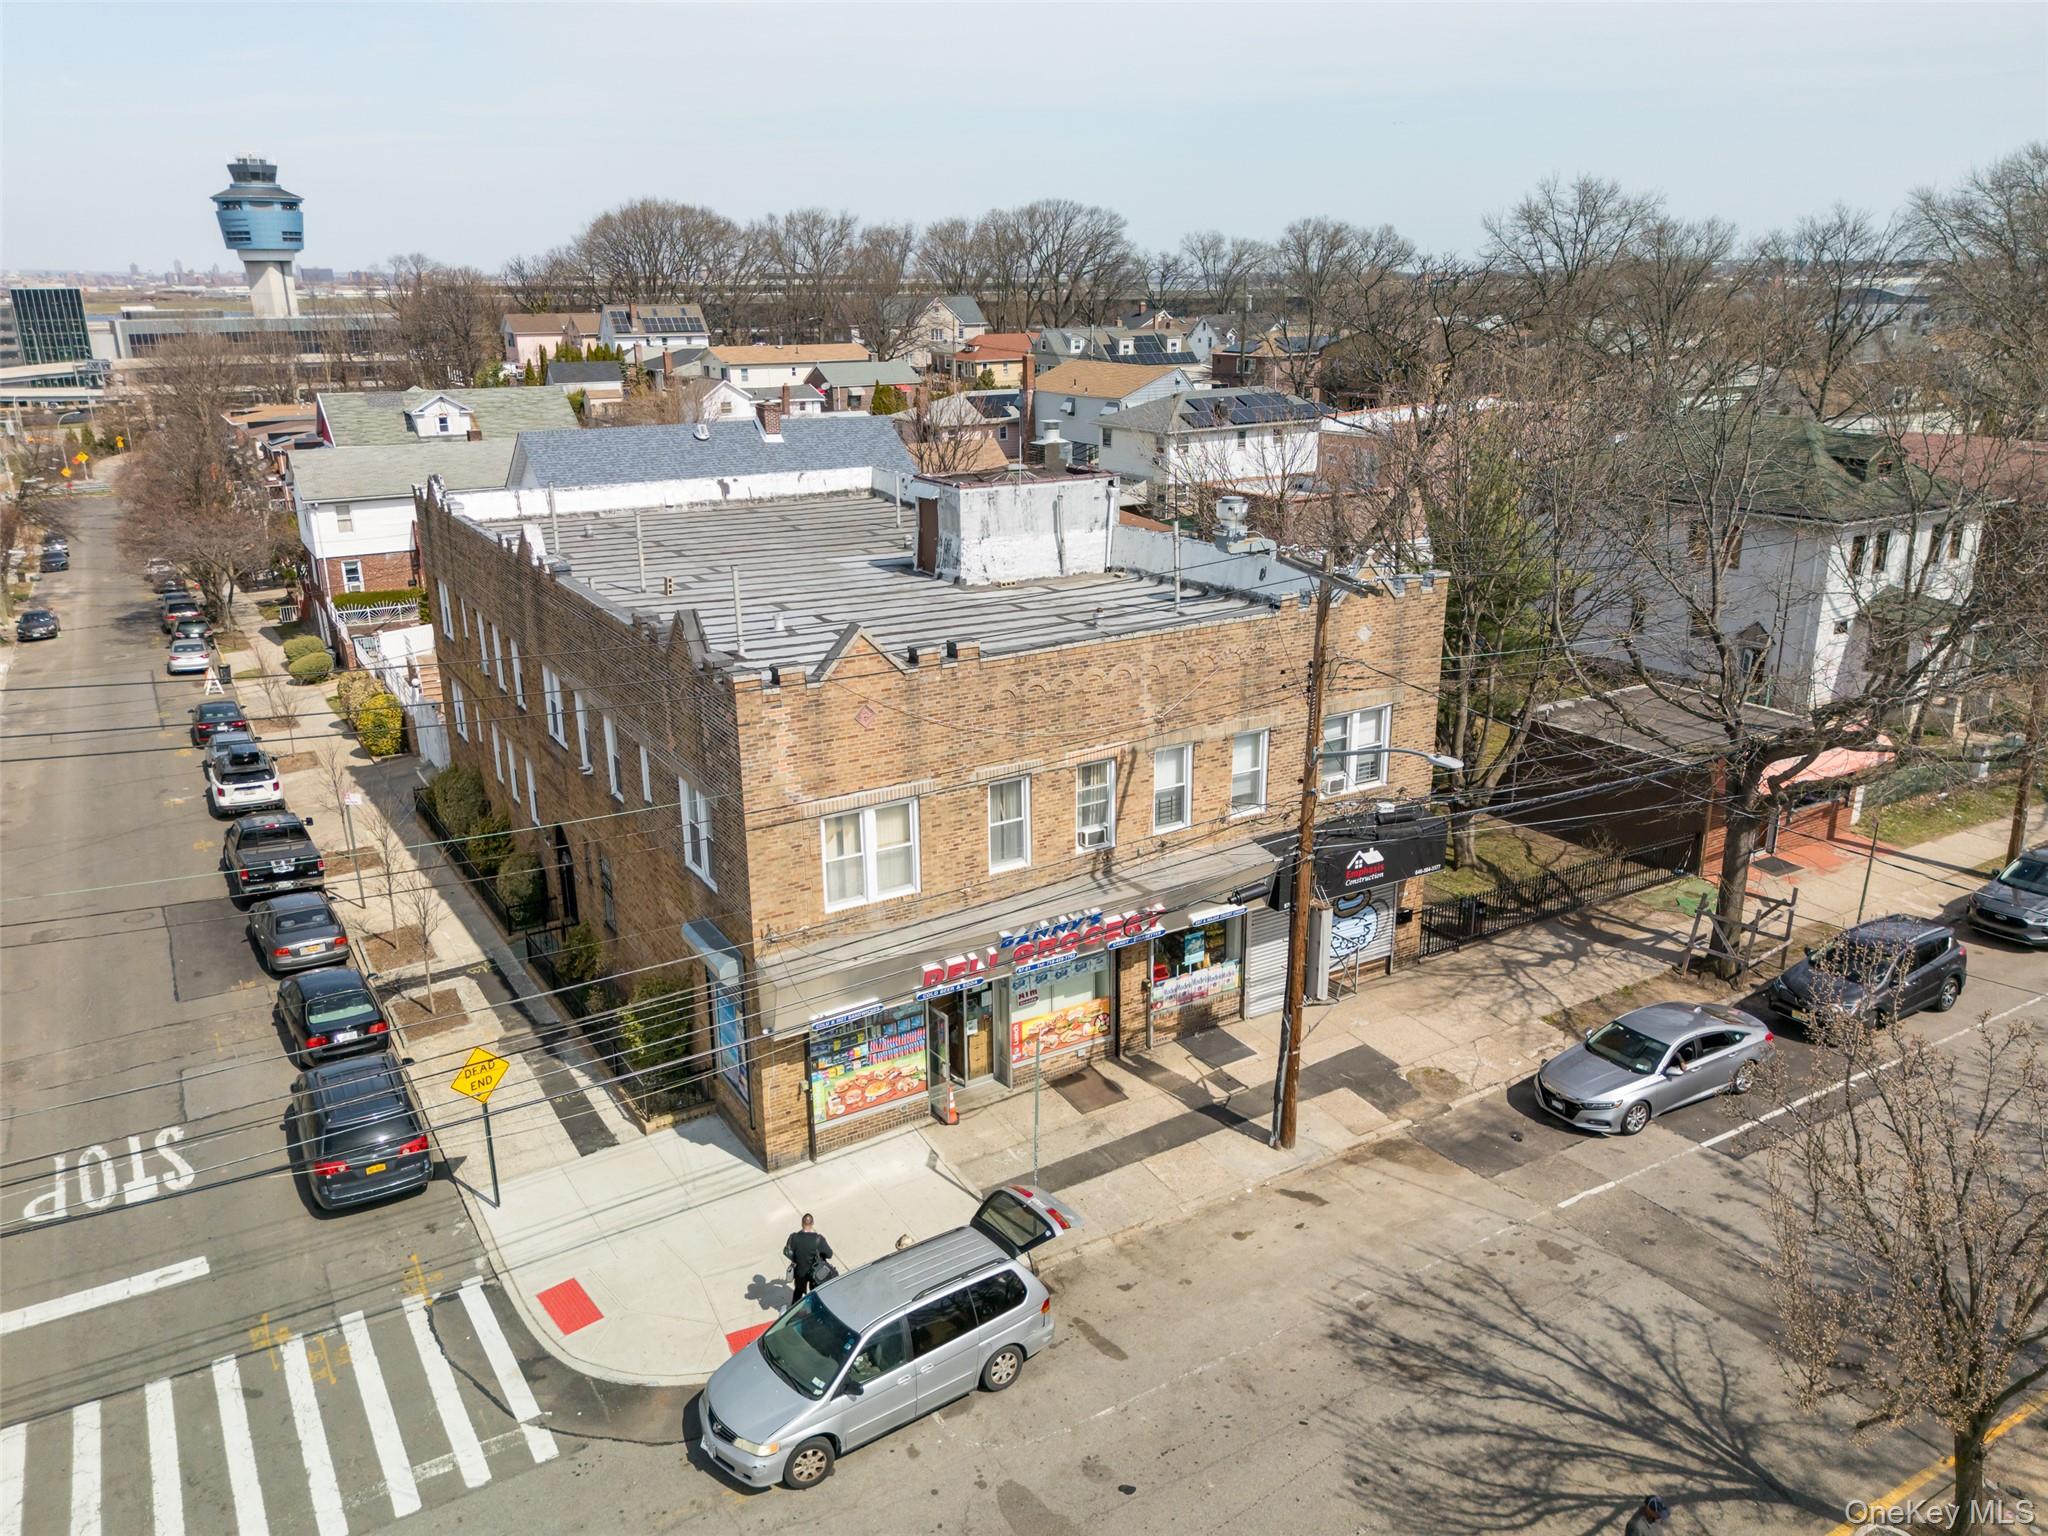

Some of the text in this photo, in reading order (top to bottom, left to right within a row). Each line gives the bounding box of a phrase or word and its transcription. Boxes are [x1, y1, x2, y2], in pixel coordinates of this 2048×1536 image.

[1345, 863, 1385, 880] Emphasis
[1345, 872, 1384, 887] Construction
[1000, 909, 1103, 948] DANNY'S
[923, 951, 998, 987] DELI
[1013, 905, 1165, 964] GROCERY
[464, 1060, 496, 1079] DEAD
[470, 1075, 493, 1091] END
[23, 1126, 196, 1222] STOP
